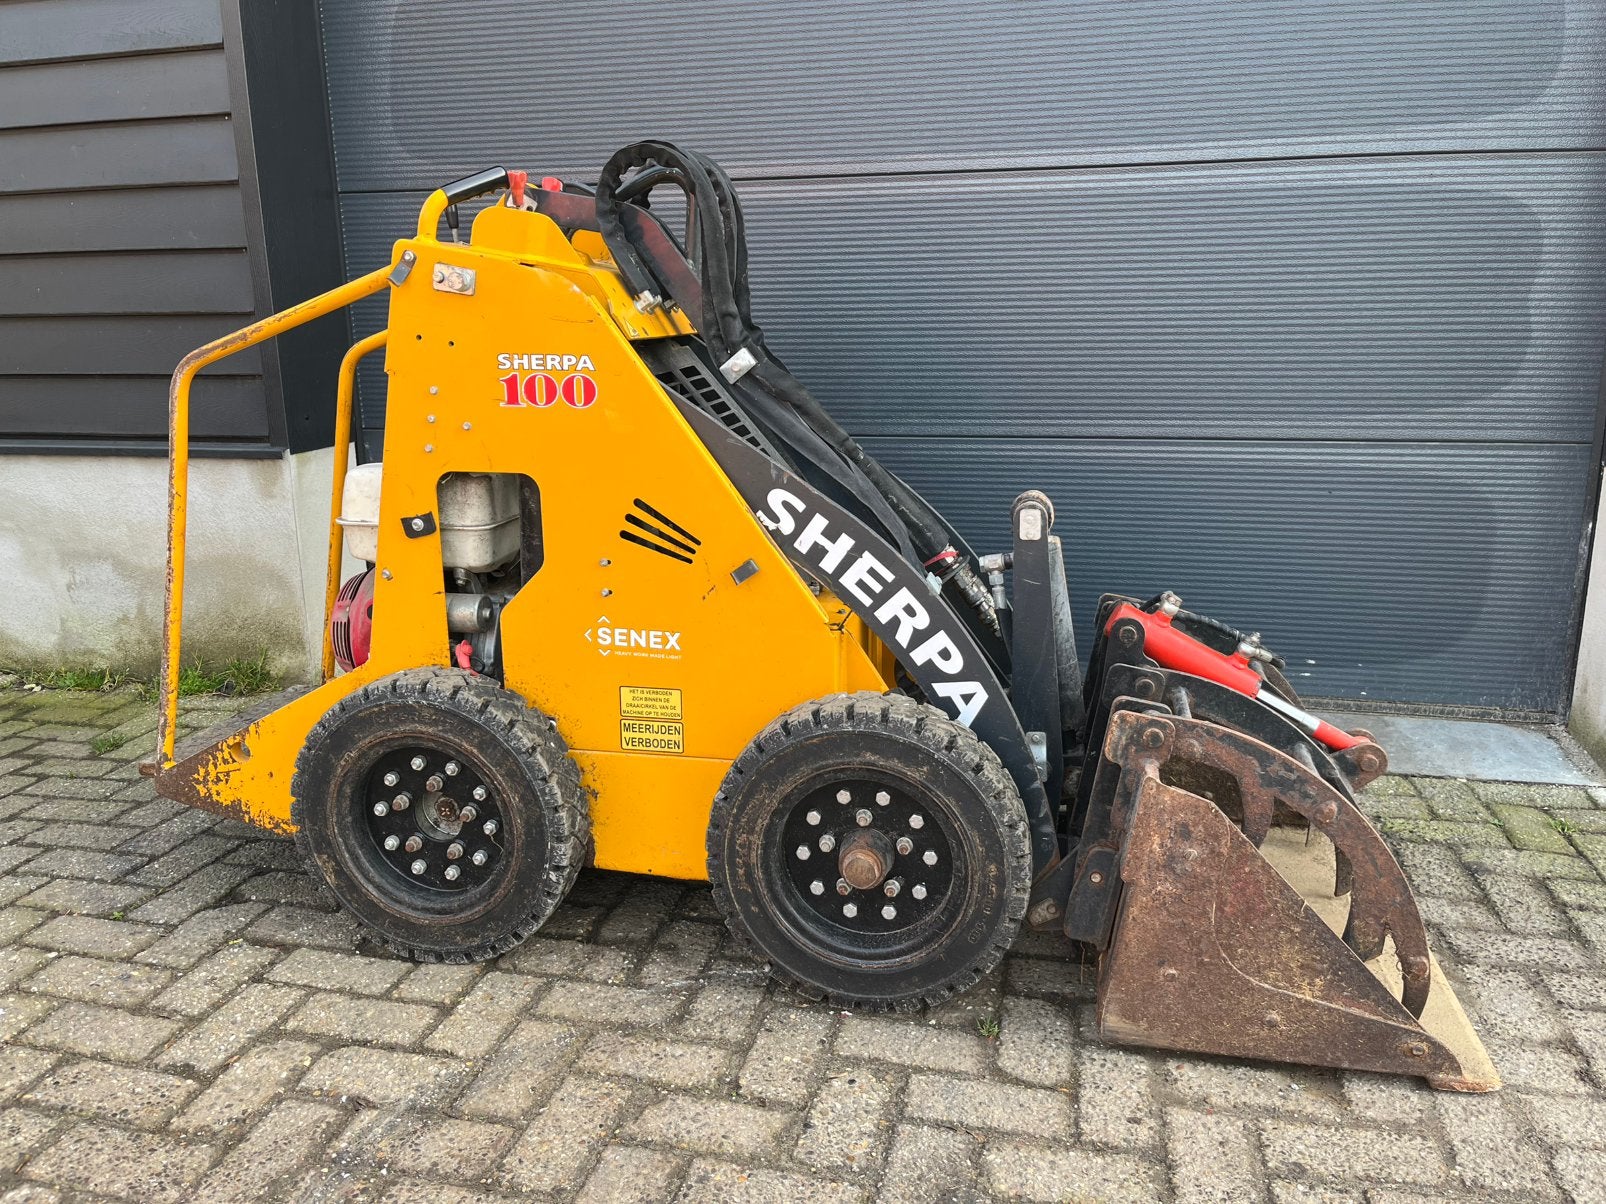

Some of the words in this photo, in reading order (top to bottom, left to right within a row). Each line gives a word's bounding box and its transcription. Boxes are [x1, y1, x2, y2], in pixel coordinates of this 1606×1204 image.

[497, 353, 596, 371] SHERPA
[499, 372, 598, 409] 100
[756, 488, 989, 728] SHERPA
[597, 627, 681, 650] SENEX
[623, 722, 681, 736] MEERIJDEN
[624, 736, 681, 750] VERBODEN
